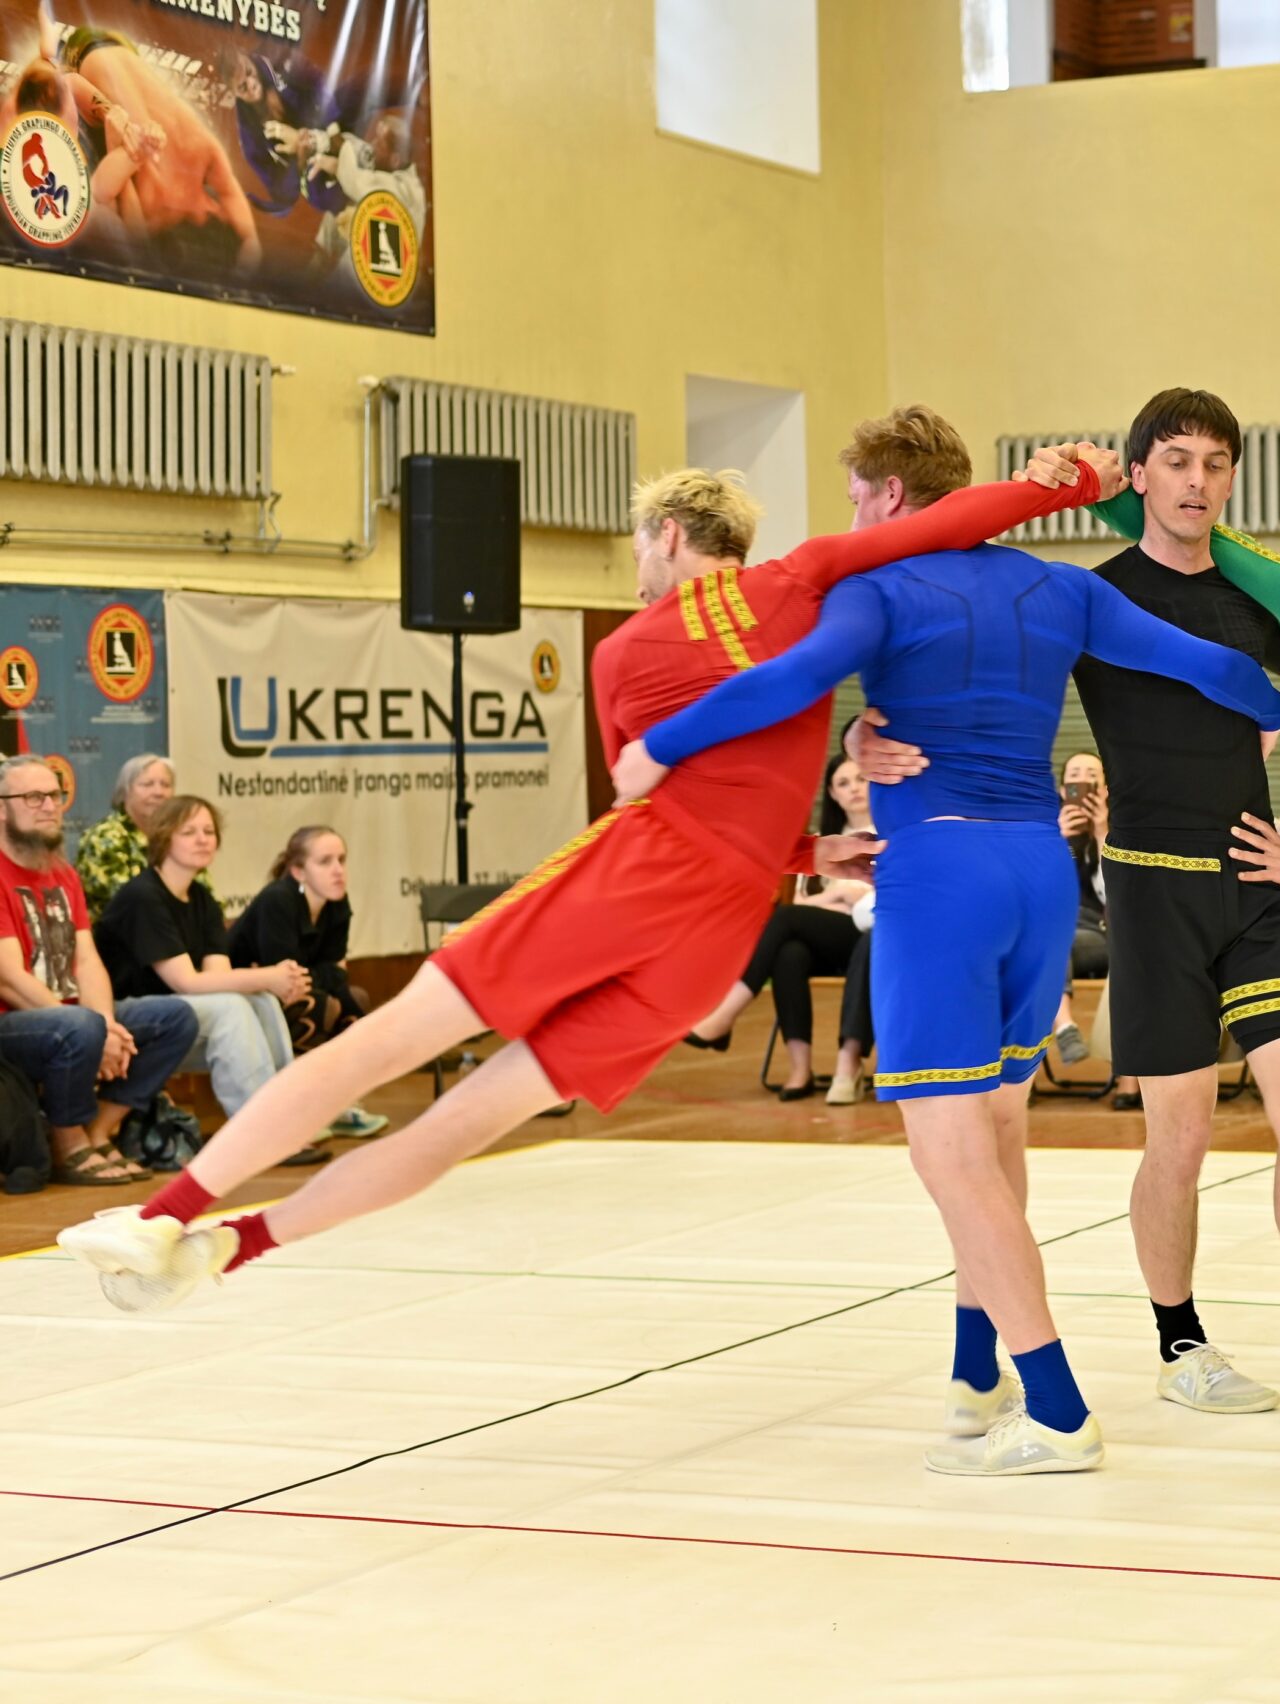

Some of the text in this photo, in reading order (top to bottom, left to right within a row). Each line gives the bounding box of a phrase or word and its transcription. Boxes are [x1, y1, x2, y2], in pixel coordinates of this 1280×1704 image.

[157, 0, 301, 42] ENYBĖS
[217, 676, 547, 758] UKRENGA
[218, 769, 349, 797] Nestandartinė
[474, 763, 550, 793] pramonei
